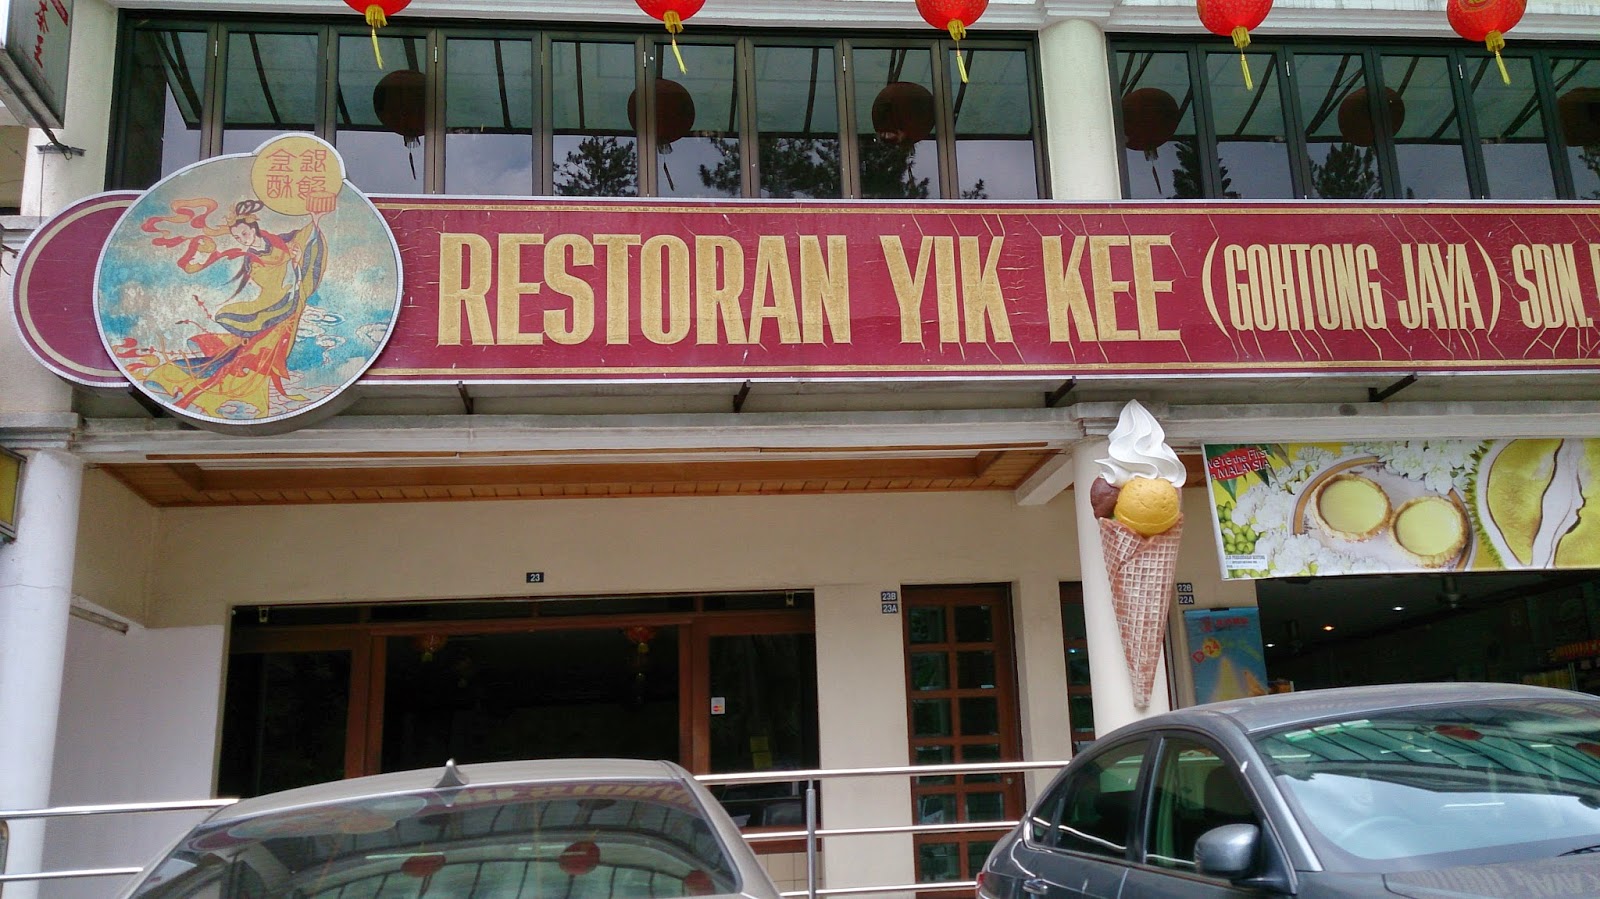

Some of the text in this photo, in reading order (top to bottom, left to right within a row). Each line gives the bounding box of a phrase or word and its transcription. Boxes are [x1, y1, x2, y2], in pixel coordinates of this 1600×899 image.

[437, 233, 852, 346] RESTORAN
[879, 235, 1013, 343] YIK
[1041, 235, 1181, 342] KEE
[1202, 236, 1388, 339] (GOHTONG
[1397, 237, 1502, 337] JAYA)
[1511, 243, 1594, 329] SDN.
[530, 573, 540, 582] 23
[1178, 584, 1192, 592] 22B
[882, 592, 897, 600] 23B
[1179, 595, 1194, 604] 22A
[883, 604, 898, 613] 23A
